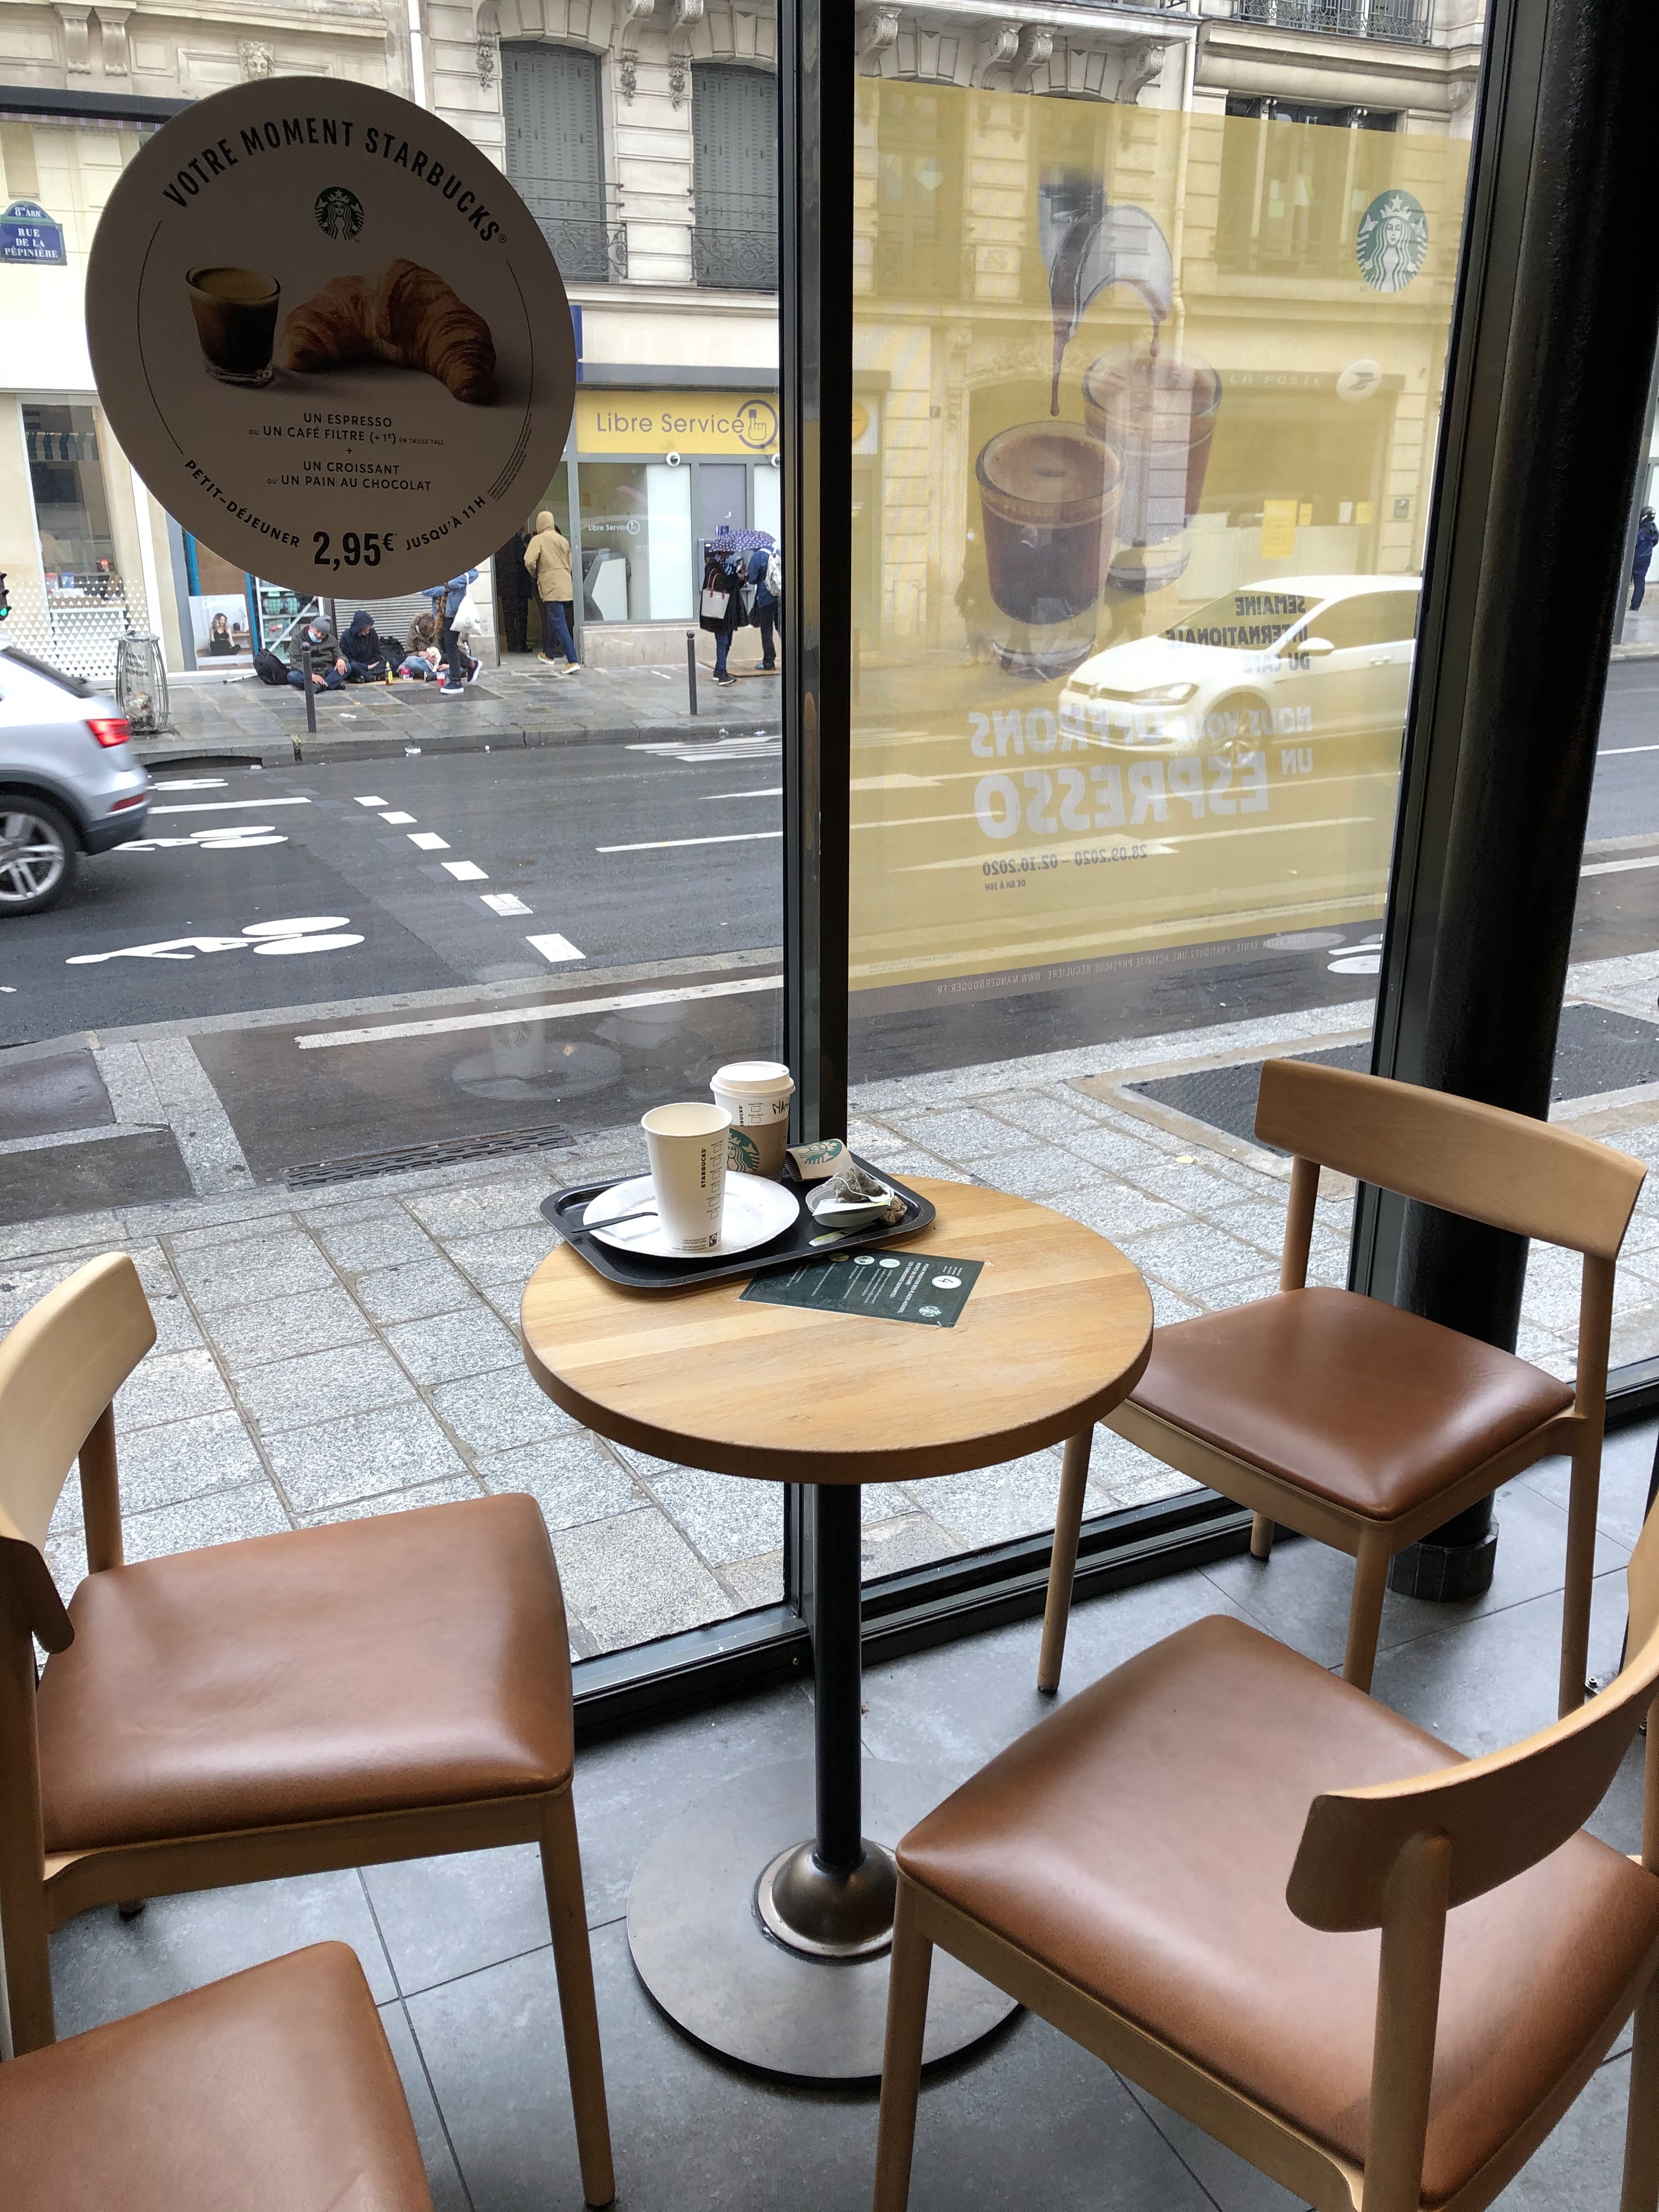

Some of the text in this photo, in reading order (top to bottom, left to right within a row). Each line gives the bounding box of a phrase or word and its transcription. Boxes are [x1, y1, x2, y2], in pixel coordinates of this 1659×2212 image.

[162, 138, 239, 207] VOTRE
[240, 117, 353, 156] MOMENT
[18, 228, 40, 238] RUE
[15, 238, 46, 247] DE LA
[4, 245, 58, 258] PÉPINIÈRE
[303, 413, 392, 427] UN ESPRESSO
[597, 412, 744, 434] Libre Service
[263, 426, 282, 437] UN
[287, 426, 320, 438] CAFÉ
[325, 428, 365, 441] FILTRE
[303, 460, 400, 475] UN CROISSANT
[281, 475, 300, 486] UN
[305, 476, 336, 488] PAIN
[341, 477, 358, 489] AU
[363, 478, 431, 491] CHOCOLAT
[184, 459, 300, 548] PETIT-DÉJEUNER
